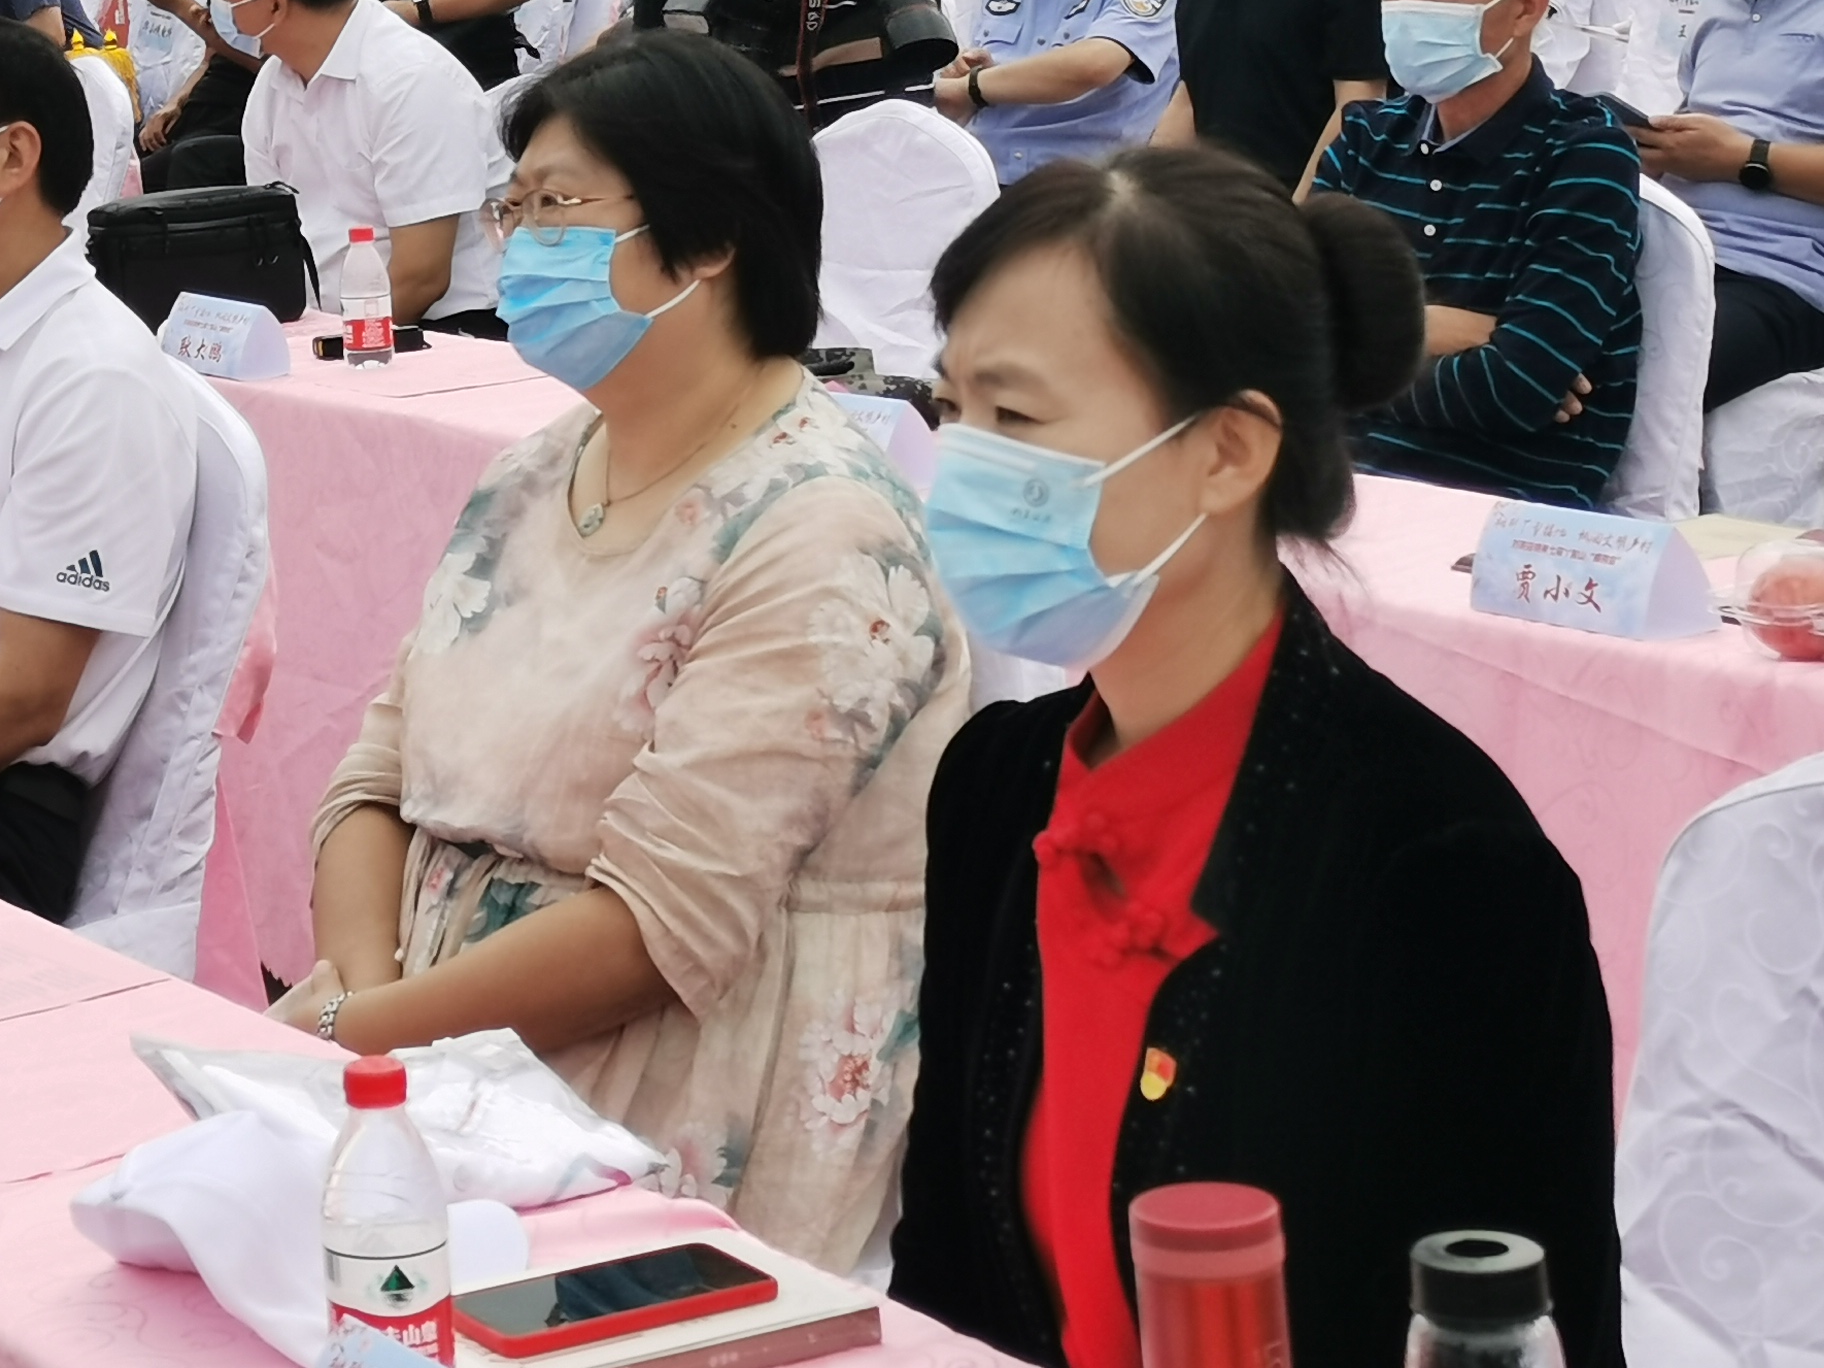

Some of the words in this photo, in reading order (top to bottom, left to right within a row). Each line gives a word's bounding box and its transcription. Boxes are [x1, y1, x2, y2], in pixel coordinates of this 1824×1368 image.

[56, 571, 111, 592] adidas
[1515, 563, 1603, 614] 贾小文
